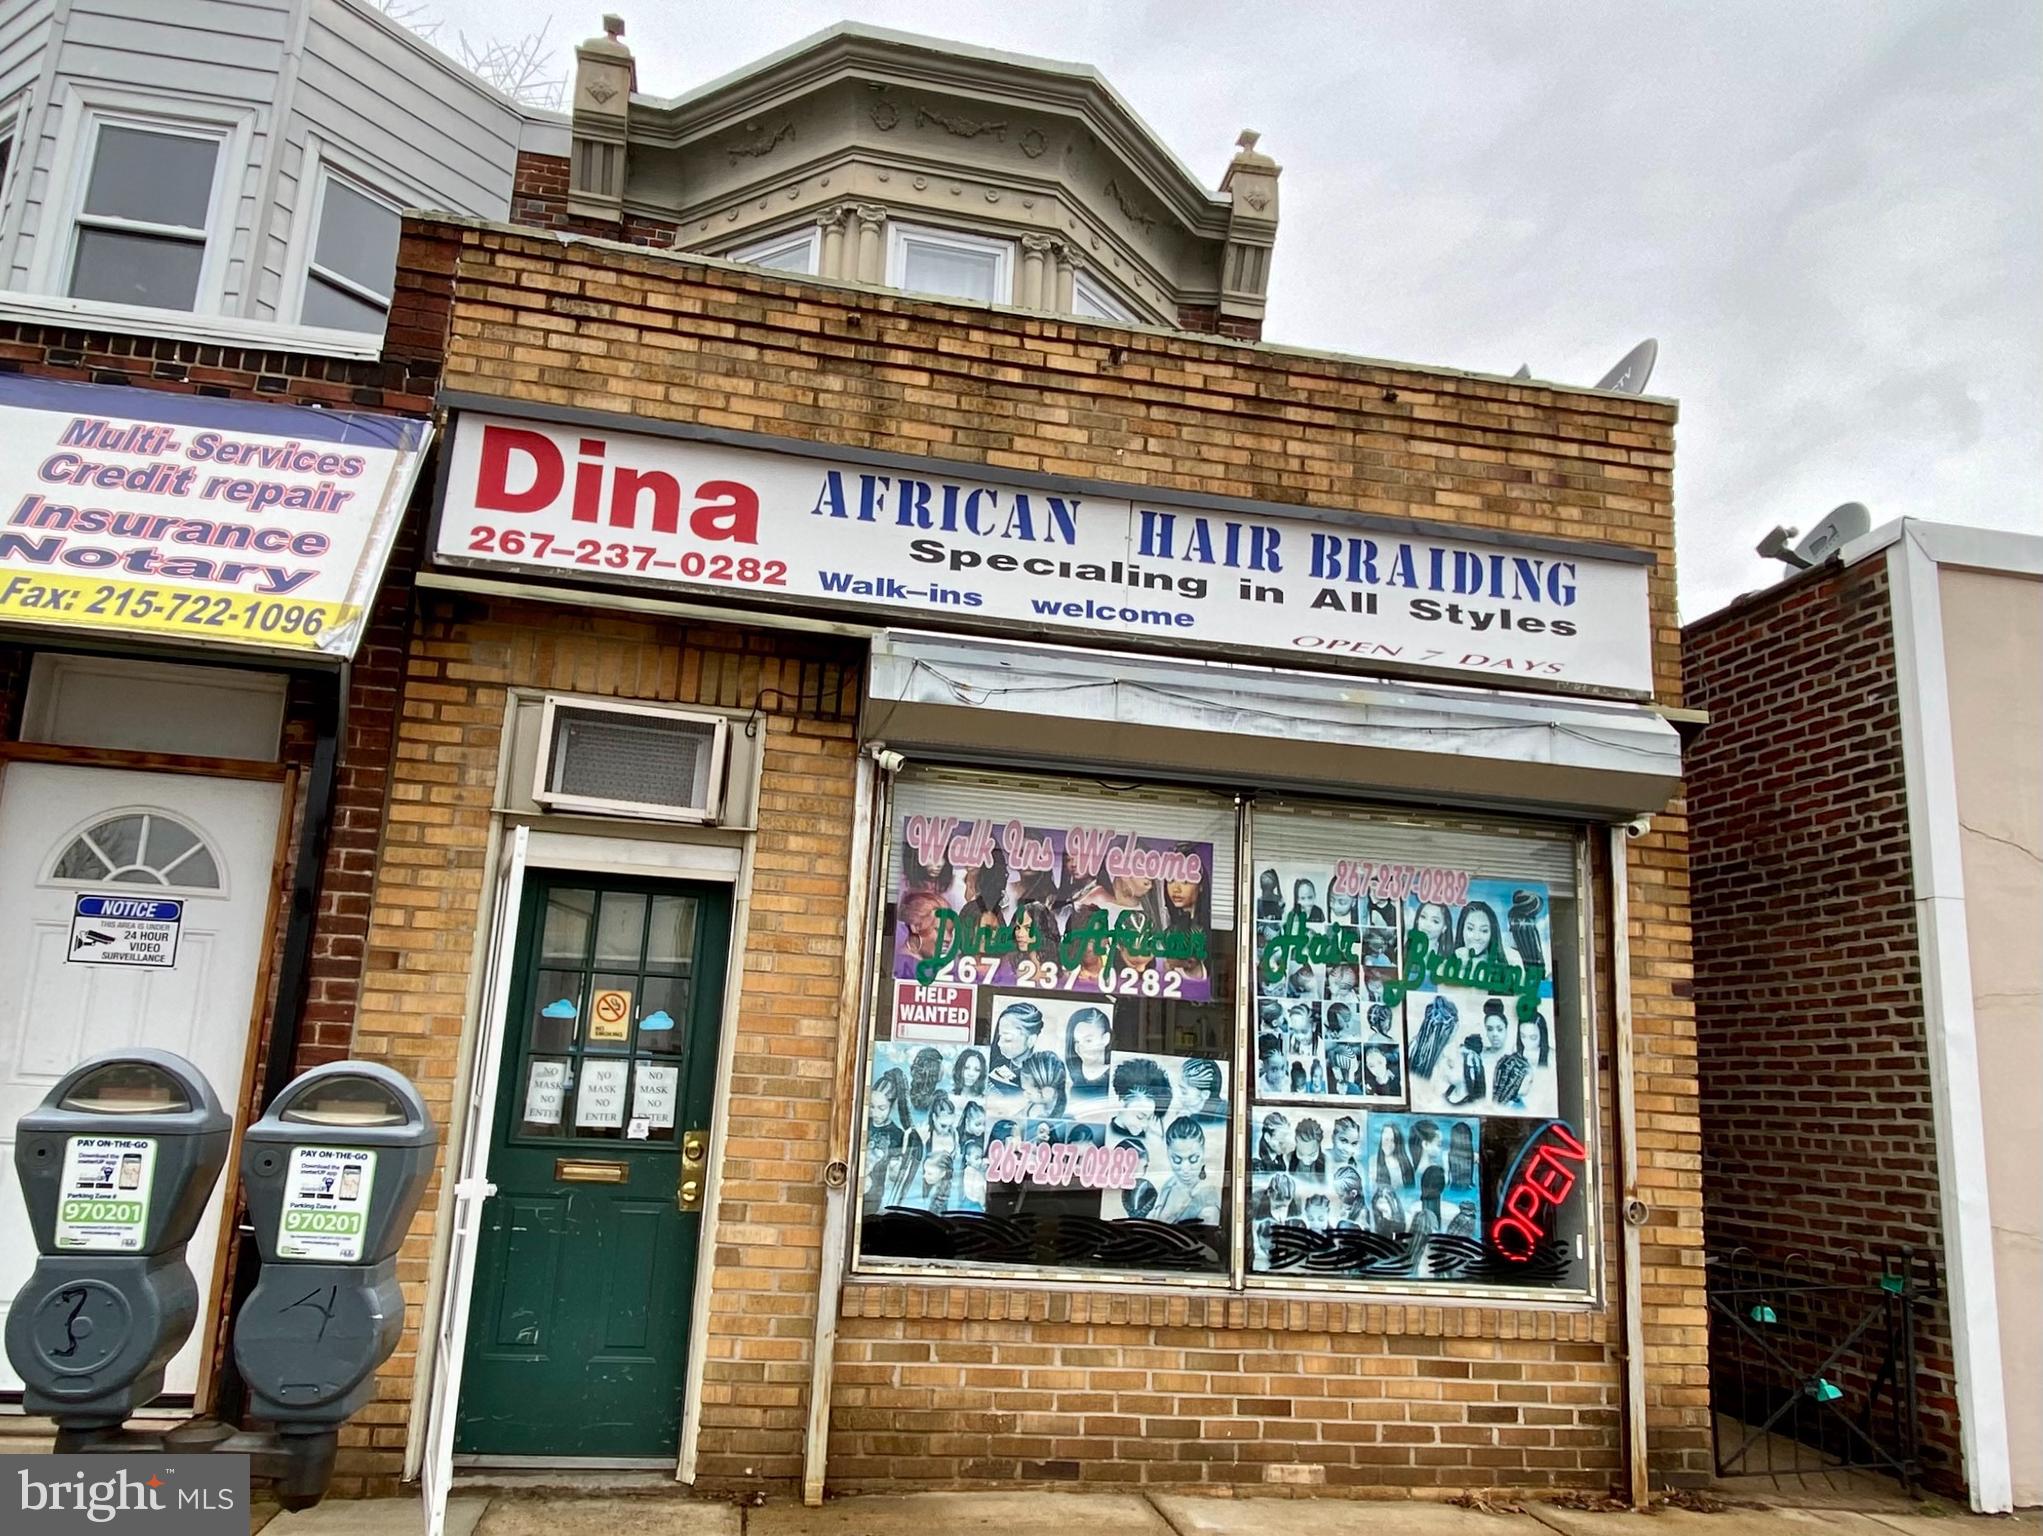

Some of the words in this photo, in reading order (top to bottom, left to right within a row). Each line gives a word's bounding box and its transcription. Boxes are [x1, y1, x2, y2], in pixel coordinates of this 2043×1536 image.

[57, 417, 181, 457] Multi-
[186, 431, 367, 481] Services
[37, 451, 196, 498] Credit
[200, 473, 355, 514] repair
[475, 424, 760, 545] Dina
[7, 494, 330, 558] Insurance
[811, 470, 1081, 545] AFRICAN
[1137, 510, 1283, 573] HAIR
[1309, 533, 1577, 608] BRAIDING
[0, 532, 321, 596] Notary
[468, 525, 788, 587] 267-237-0282
[909, 539, 1208, 599] Specialing
[1239, 578, 1284, 604] in
[1310, 588, 1378, 615] All
[1409, 598, 1577, 637] Styles
[1, 576, 78, 611] Fax:
[85, 584, 327, 637] 215-722-1096
[818, 570, 983, 607] Walk-ins
[1032, 599, 1195, 628] welcome
[1292, 635, 1403, 657] OPEN
[1419, 649, 1445, 661] 7
[1459, 653, 1565, 674] DAYS
[907, 814, 996, 869] Walk
[1002, 818, 1055, 872] Ins
[1066, 825, 1202, 884] Welcome
[1333, 859, 1468, 907] 267-237-0282
[101, 900, 158, 918] NOTICE
[124, 931, 137, 940] 24
[140, 932, 169, 942] HOUR
[146, 923, 170, 931] UNDER
[101, 951, 166, 963] SURVEILLANCE
[130, 942, 161, 953] VIDEO
[1264, 911, 1360, 983] Hair
[1383, 929, 1545, 1022] Braiding
[1098, 966, 1182, 998] 0282
[914, 986, 957, 1005] HELP
[900, 1003, 970, 1025] WANTED
[544, 1066, 559, 1075] NO
[597, 1071, 612, 1079] NO
[648, 1071, 663, 1080] NO
[535, 1080, 562, 1090] MASK
[588, 1085, 616, 1094] MASK
[640, 1086, 668, 1094] MASK
[540, 1094, 555, 1103] NO
[595, 1099, 610, 1107] NO
[648, 1099, 662, 1108] NO
[585, 1112, 617, 1121] ENTER
[77, 1139, 95, 1147] PAY
[97, 1140, 148, 1149] ON-THE-GO
[319, 1151, 368, 1160] ON-THE-GO
[986, 1140, 1139, 1189] 267-237-0282
[1492, 1125, 1587, 1262] OPEN
[65, 1202, 140, 1221] 970201
[287, 1212, 360, 1232] 970201
